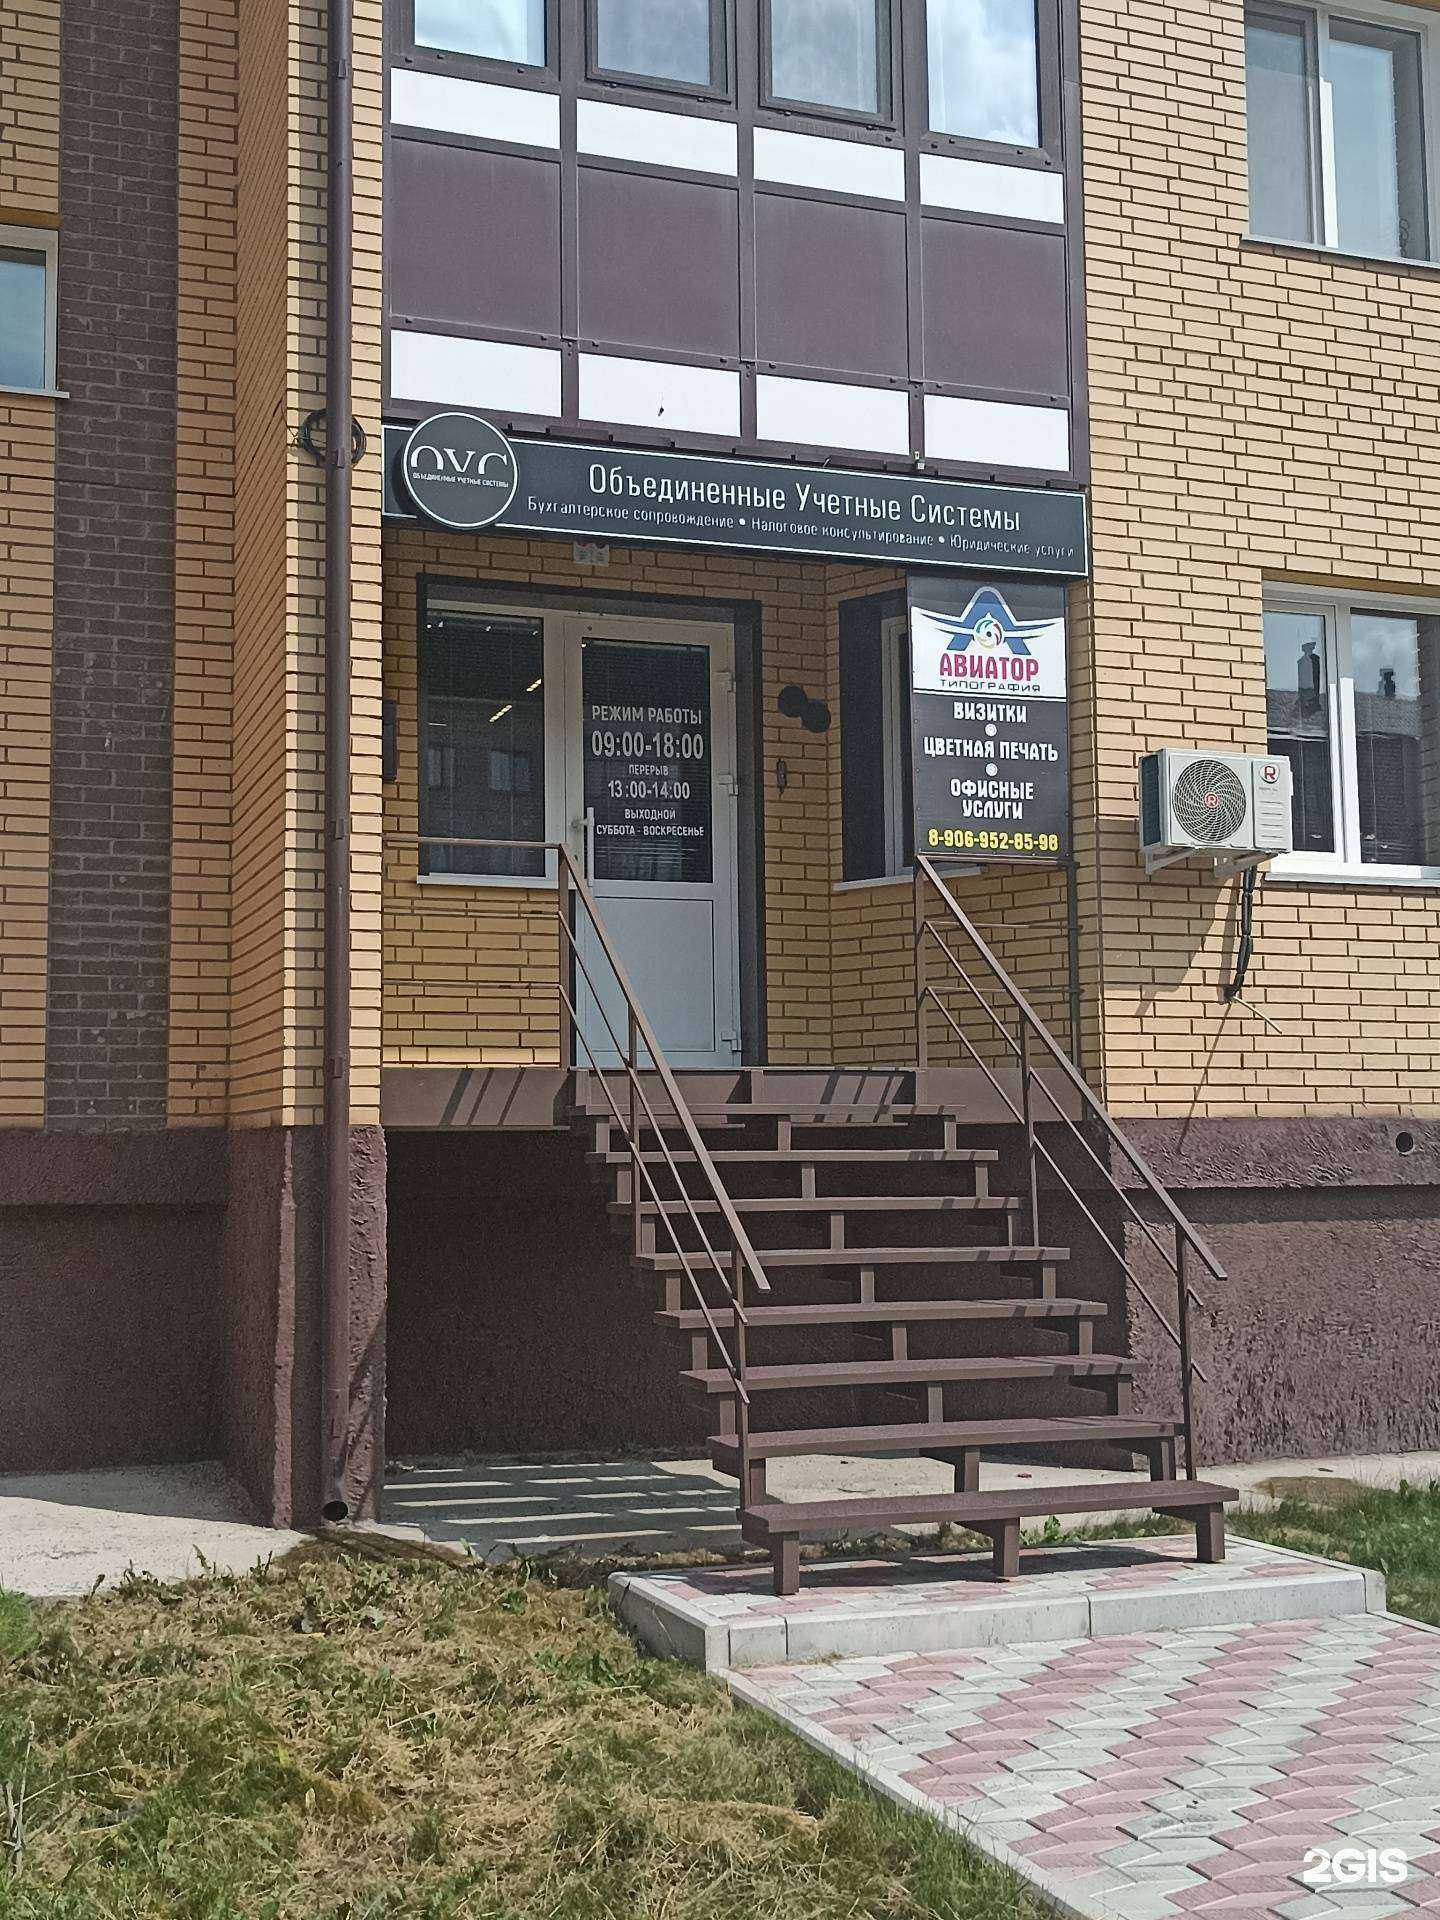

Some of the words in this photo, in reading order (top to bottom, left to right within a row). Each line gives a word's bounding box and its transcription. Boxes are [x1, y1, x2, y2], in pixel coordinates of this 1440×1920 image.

[589, 463, 786, 510] Объединенные
[795, 482, 901, 520] Учетные
[910, 494, 1021, 531] Системы
[528, 496, 629, 519] Бухгалтерское
[633, 509, 735, 528] сопровождение
[751, 517, 818, 536] Налоговое
[822, 526, 934, 546] консультирование
[950, 534, 1030, 553] Юридические
[1035, 545, 1074, 558] услуги
[939, 652, 1039, 682] АВИАТОР
[940, 679, 1041, 692] ТИПОГРАФИЯ
[592, 705, 644, 722] РЕЖИМ
[648, 707, 702, 725] РАБОТЫ
[953, 702, 1027, 723] ВИЗИТКИ
[591, 730, 704, 759] 09:00-18:00
[923, 737, 995, 758] ЦВЕТНАЯ
[999, 741, 1059, 762] ПЕЧАТЬ
[628, 764, 669, 776] ПЕРЕРЫВ
[950, 778, 1034, 800] ОФИСНЫЕ
[624, 807, 676, 820] ВЫХОДНОЙ
[962, 800, 1023, 820] УСЛУГИ
[596, 824, 636, 836] СУББОТА
[643, 825, 705, 837] ВОСКРЕСЕНЬЕ
[928, 828, 1059, 851] 8-906-952-85-98
